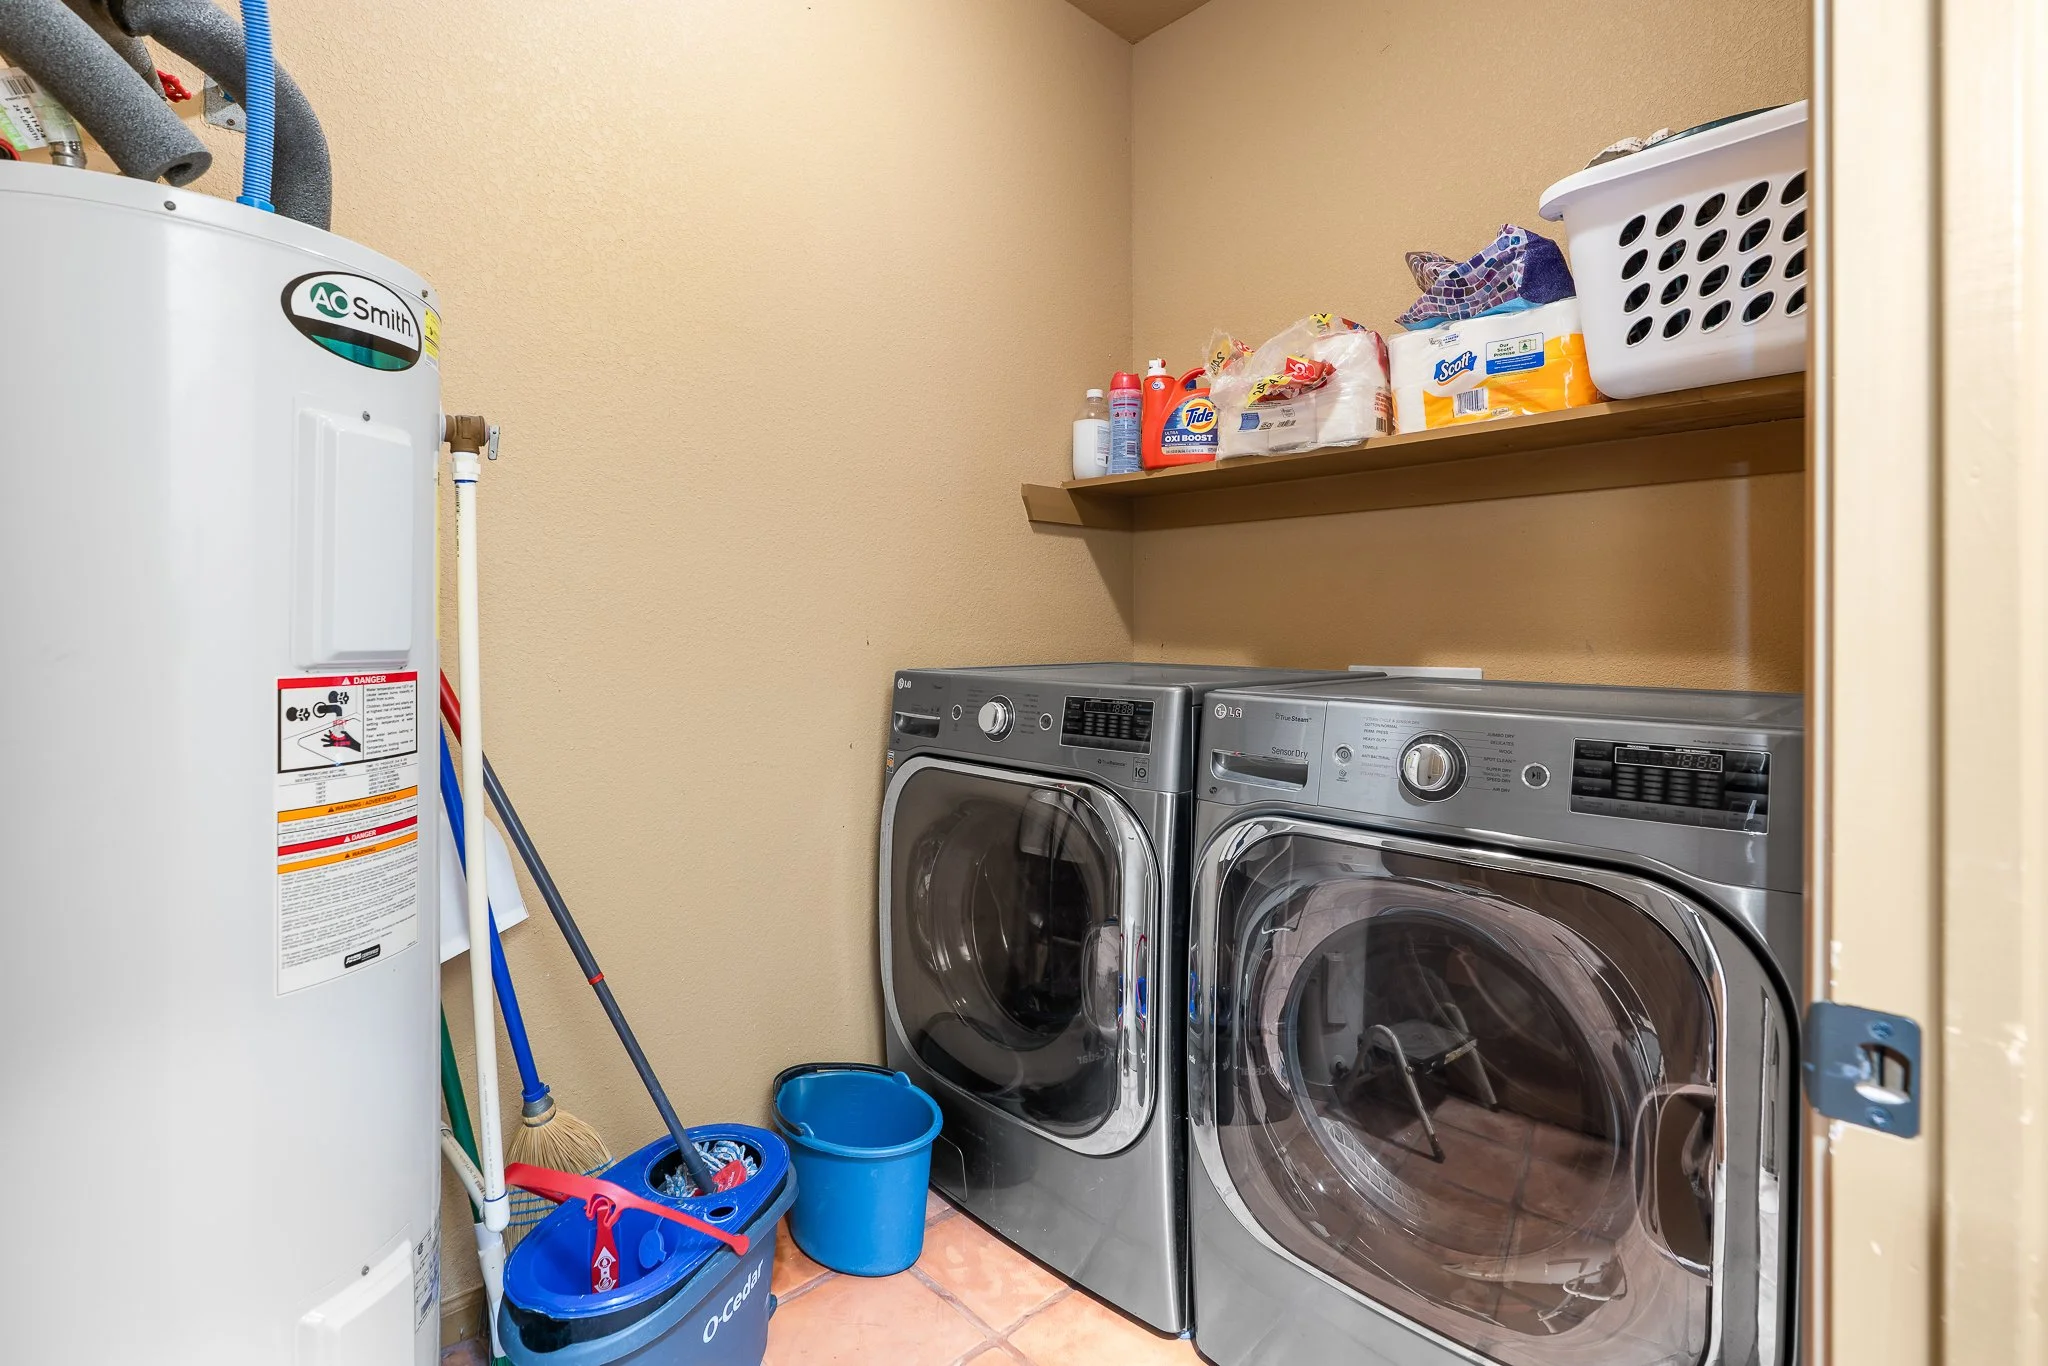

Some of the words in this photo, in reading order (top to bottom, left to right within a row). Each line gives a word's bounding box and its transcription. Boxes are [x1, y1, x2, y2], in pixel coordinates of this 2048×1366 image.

[312, 286, 350, 315] AO
[353, 297, 411, 337] Smith
[1439, 351, 1472, 380] Scott
[1186, 407, 1214, 427] Tide
[1164, 434, 1180, 442] OXI
[1181, 434, 1213, 442] BOOST
[353, 675, 387, 685] DANGER
[1228, 706, 1242, 718] LG
[1271, 746, 1295, 756] Sensor
[1295, 749, 1308, 759] Dry
[351, 830, 377, 841] DANGER
[703, 1258, 764, 1344] O-Cedar
